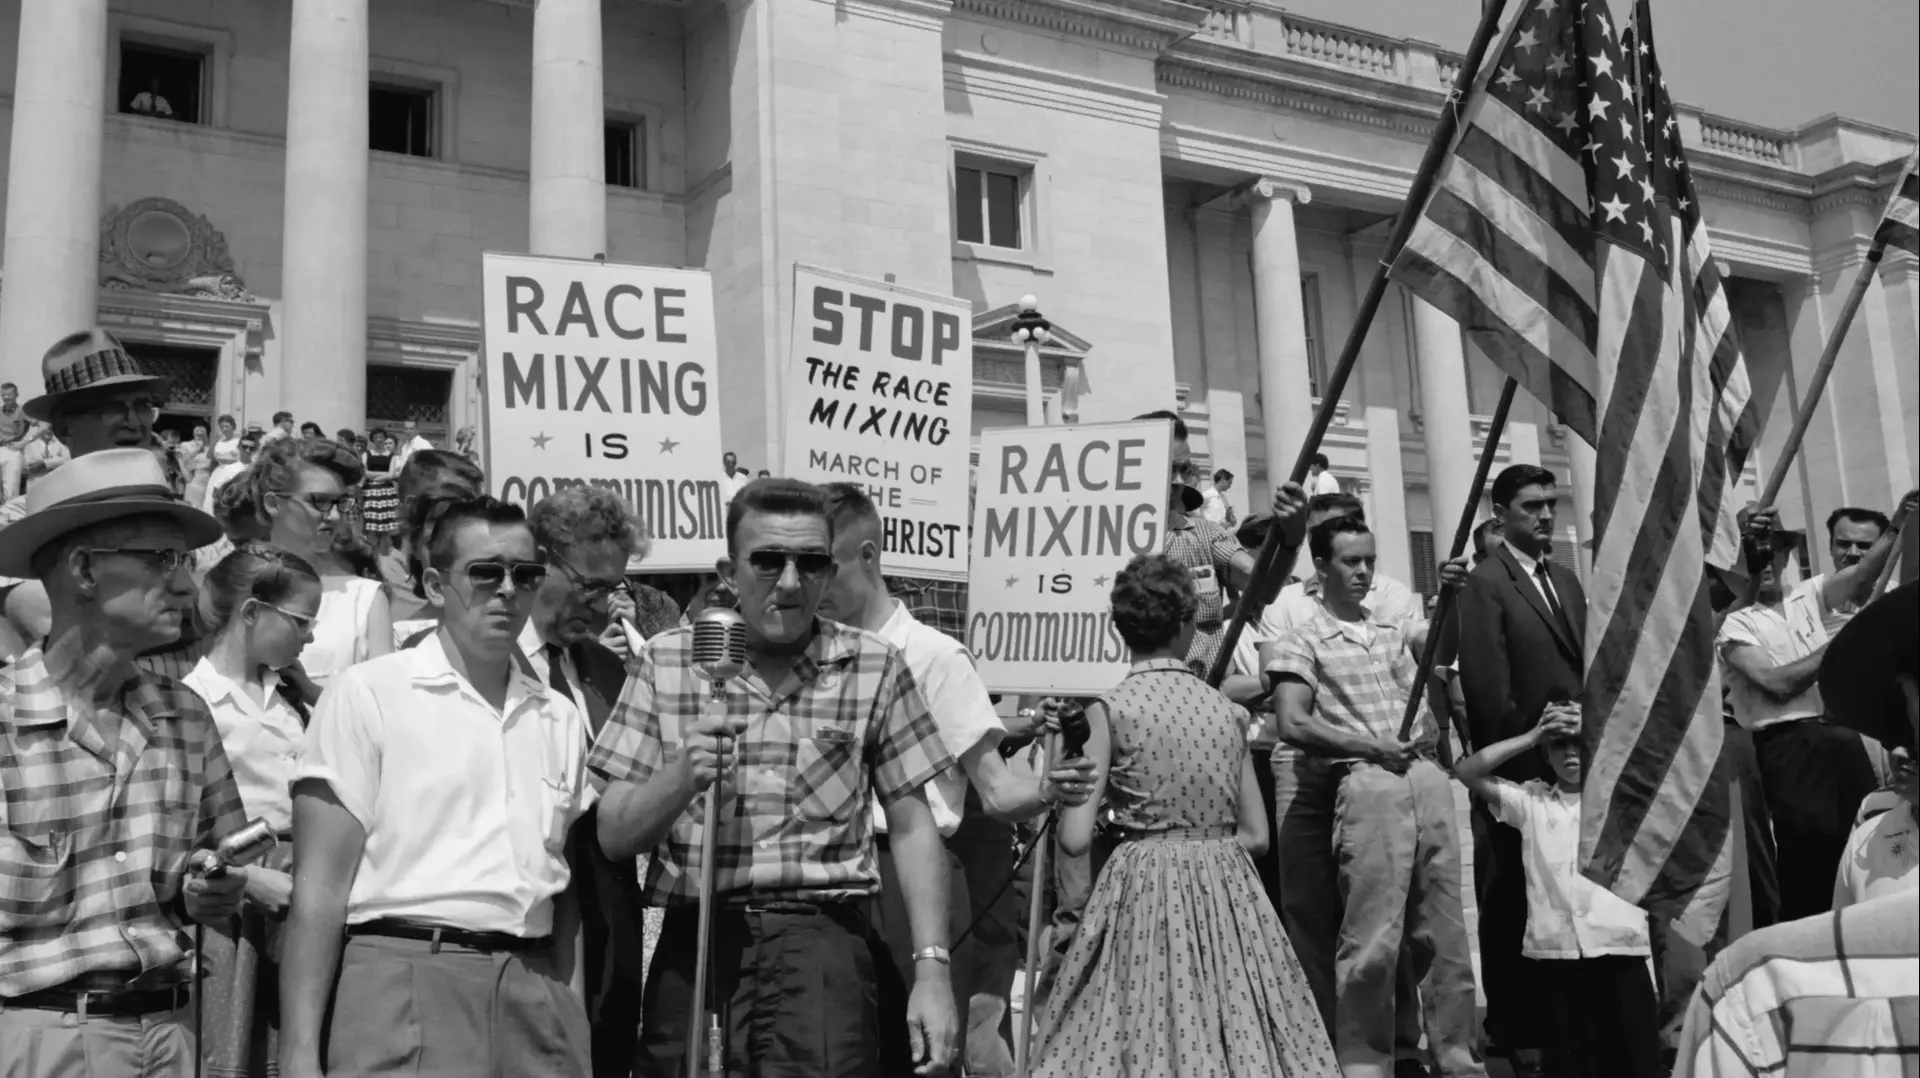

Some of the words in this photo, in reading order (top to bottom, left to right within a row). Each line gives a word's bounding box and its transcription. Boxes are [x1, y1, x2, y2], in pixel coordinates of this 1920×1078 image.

[505, 275, 687, 343] RACE
[812, 285, 960, 366] STOP
[502, 351, 707, 417] MIXING
[805, 356, 860, 391] THE
[872, 370, 951, 406] RACE
[584, 432, 629, 460] IS
[809, 396, 950, 446] MIXING
[809, 448, 899, 481] MARCH
[910, 464, 943, 485] OF
[999, 438, 1146, 495] RACE
[882, 516, 961, 559] HRIST
[983, 502, 1157, 558] MIXING
[1038, 573, 1073, 594] IS
